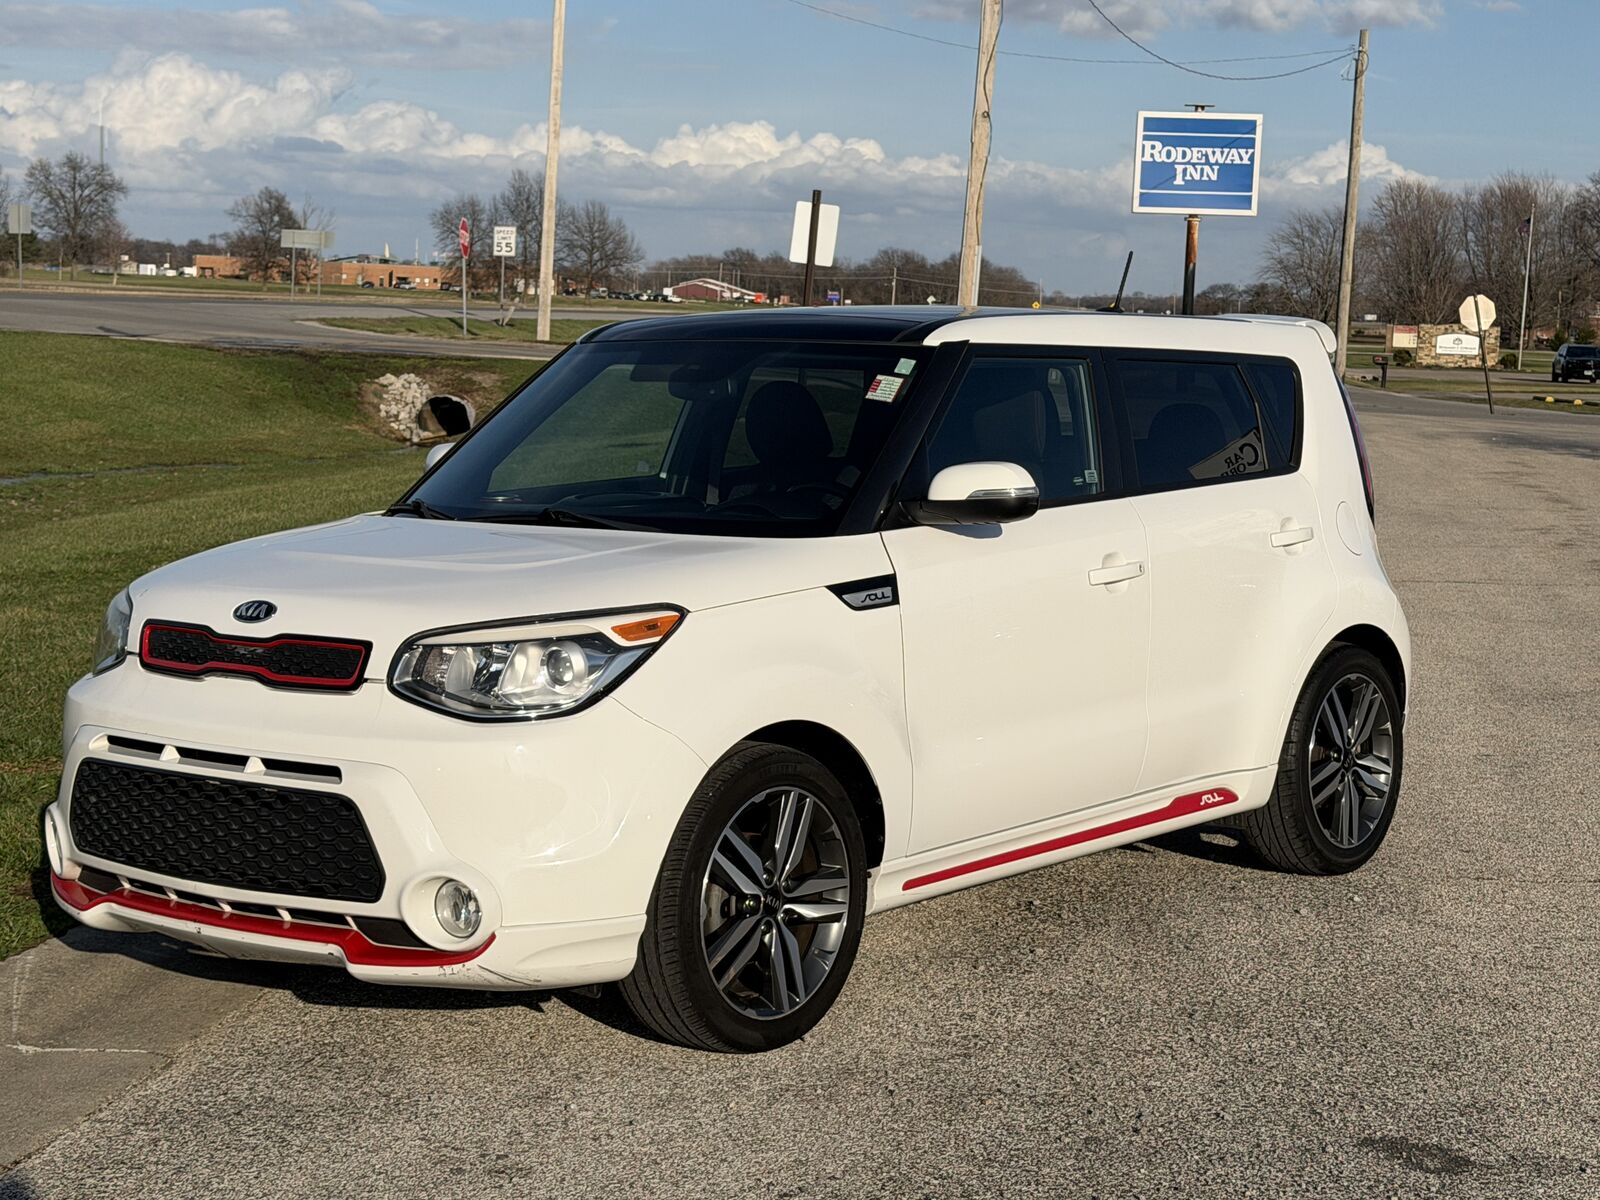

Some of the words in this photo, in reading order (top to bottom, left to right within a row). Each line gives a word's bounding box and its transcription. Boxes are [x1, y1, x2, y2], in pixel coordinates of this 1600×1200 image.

[1141, 140, 1255, 165] RODEWAY
[1173, 164, 1219, 185] INN
[496, 242, 513, 253] 55
[860, 591, 890, 603] SOUL
[236, 602, 268, 618] KIA
[1200, 792, 1224, 805] SOUL
